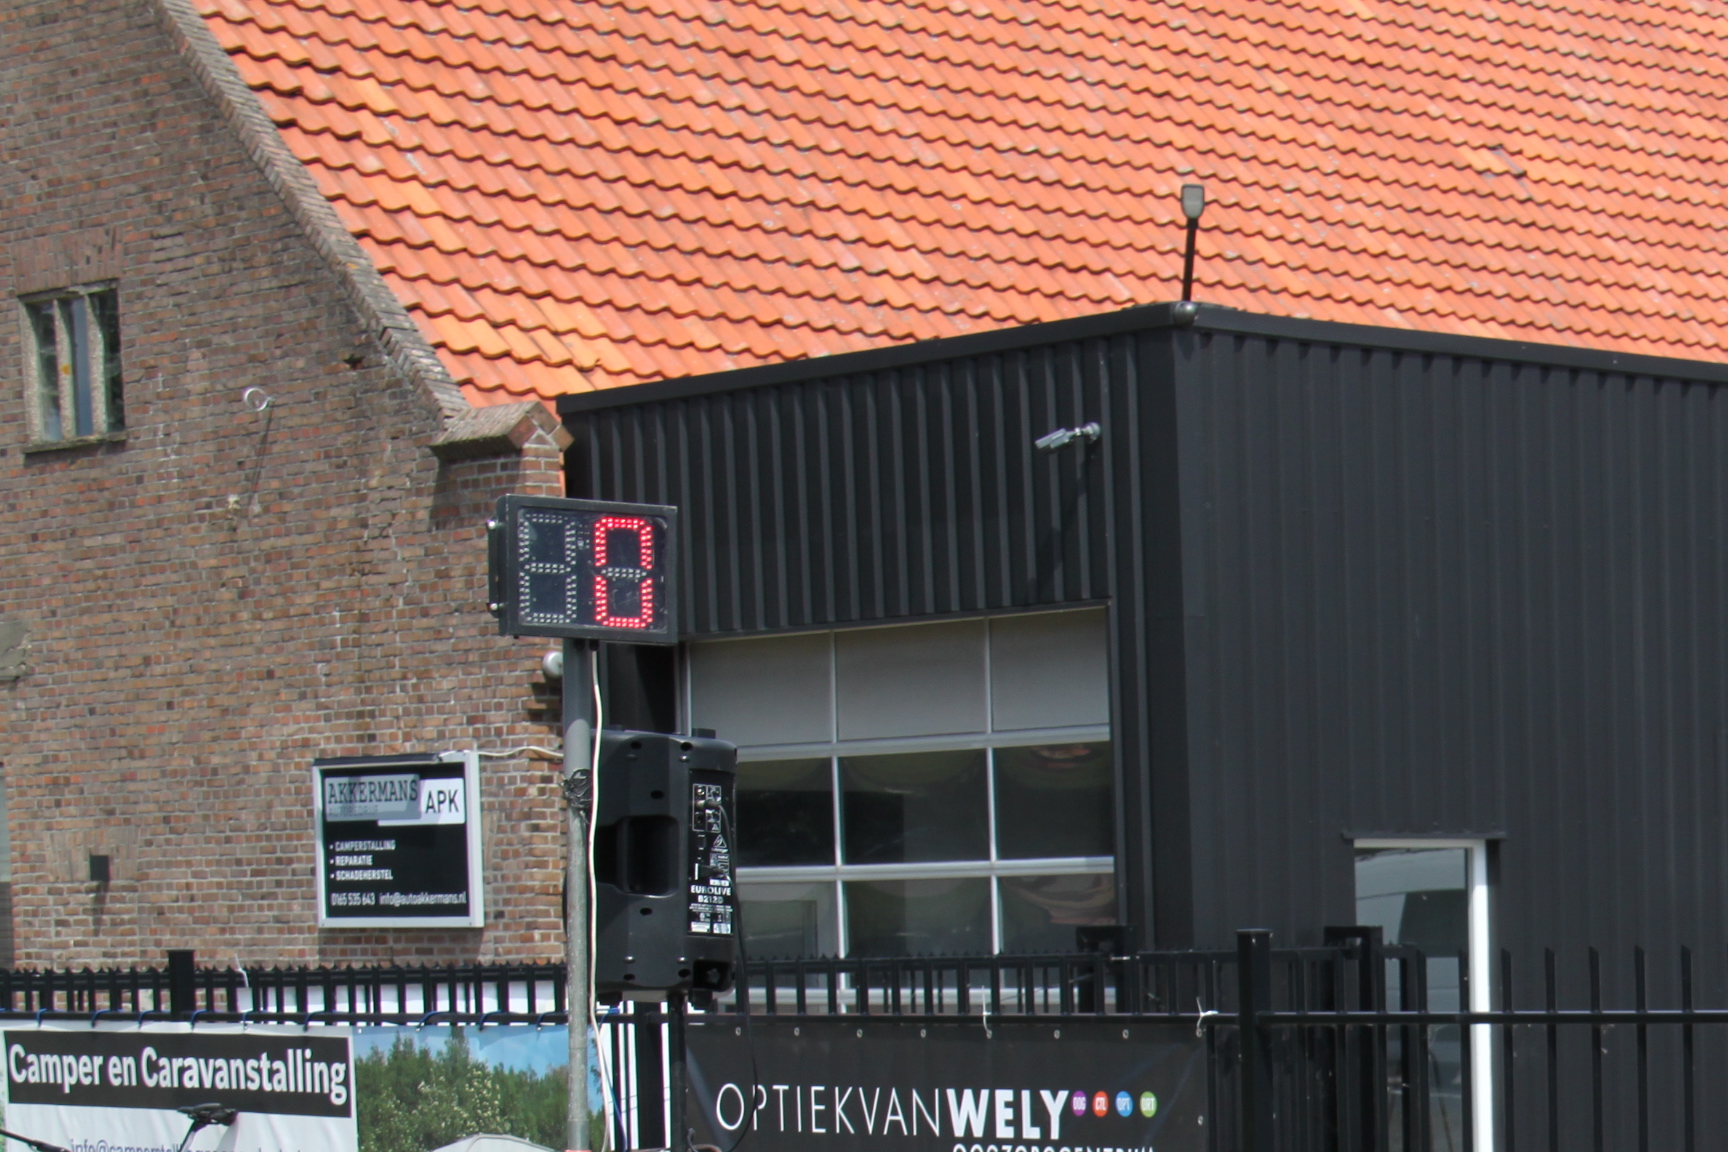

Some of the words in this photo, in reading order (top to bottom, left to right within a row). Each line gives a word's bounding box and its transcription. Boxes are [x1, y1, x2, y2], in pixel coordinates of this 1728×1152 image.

[328, 780, 418, 804] AKKERMANS
[425, 789, 459, 813] APK
[335, 840, 396, 851] CAMPERSTALLING
[335, 854, 373, 866] REPARATIE
[336, 869, 393, 881] SCHADEHERSTEL
[690, 884, 732, 896] EUROLIVE
[9, 1044, 103, 1093] Camper
[108, 1053, 137, 1086] en
[141, 1046, 347, 1105] Caravanstalling
